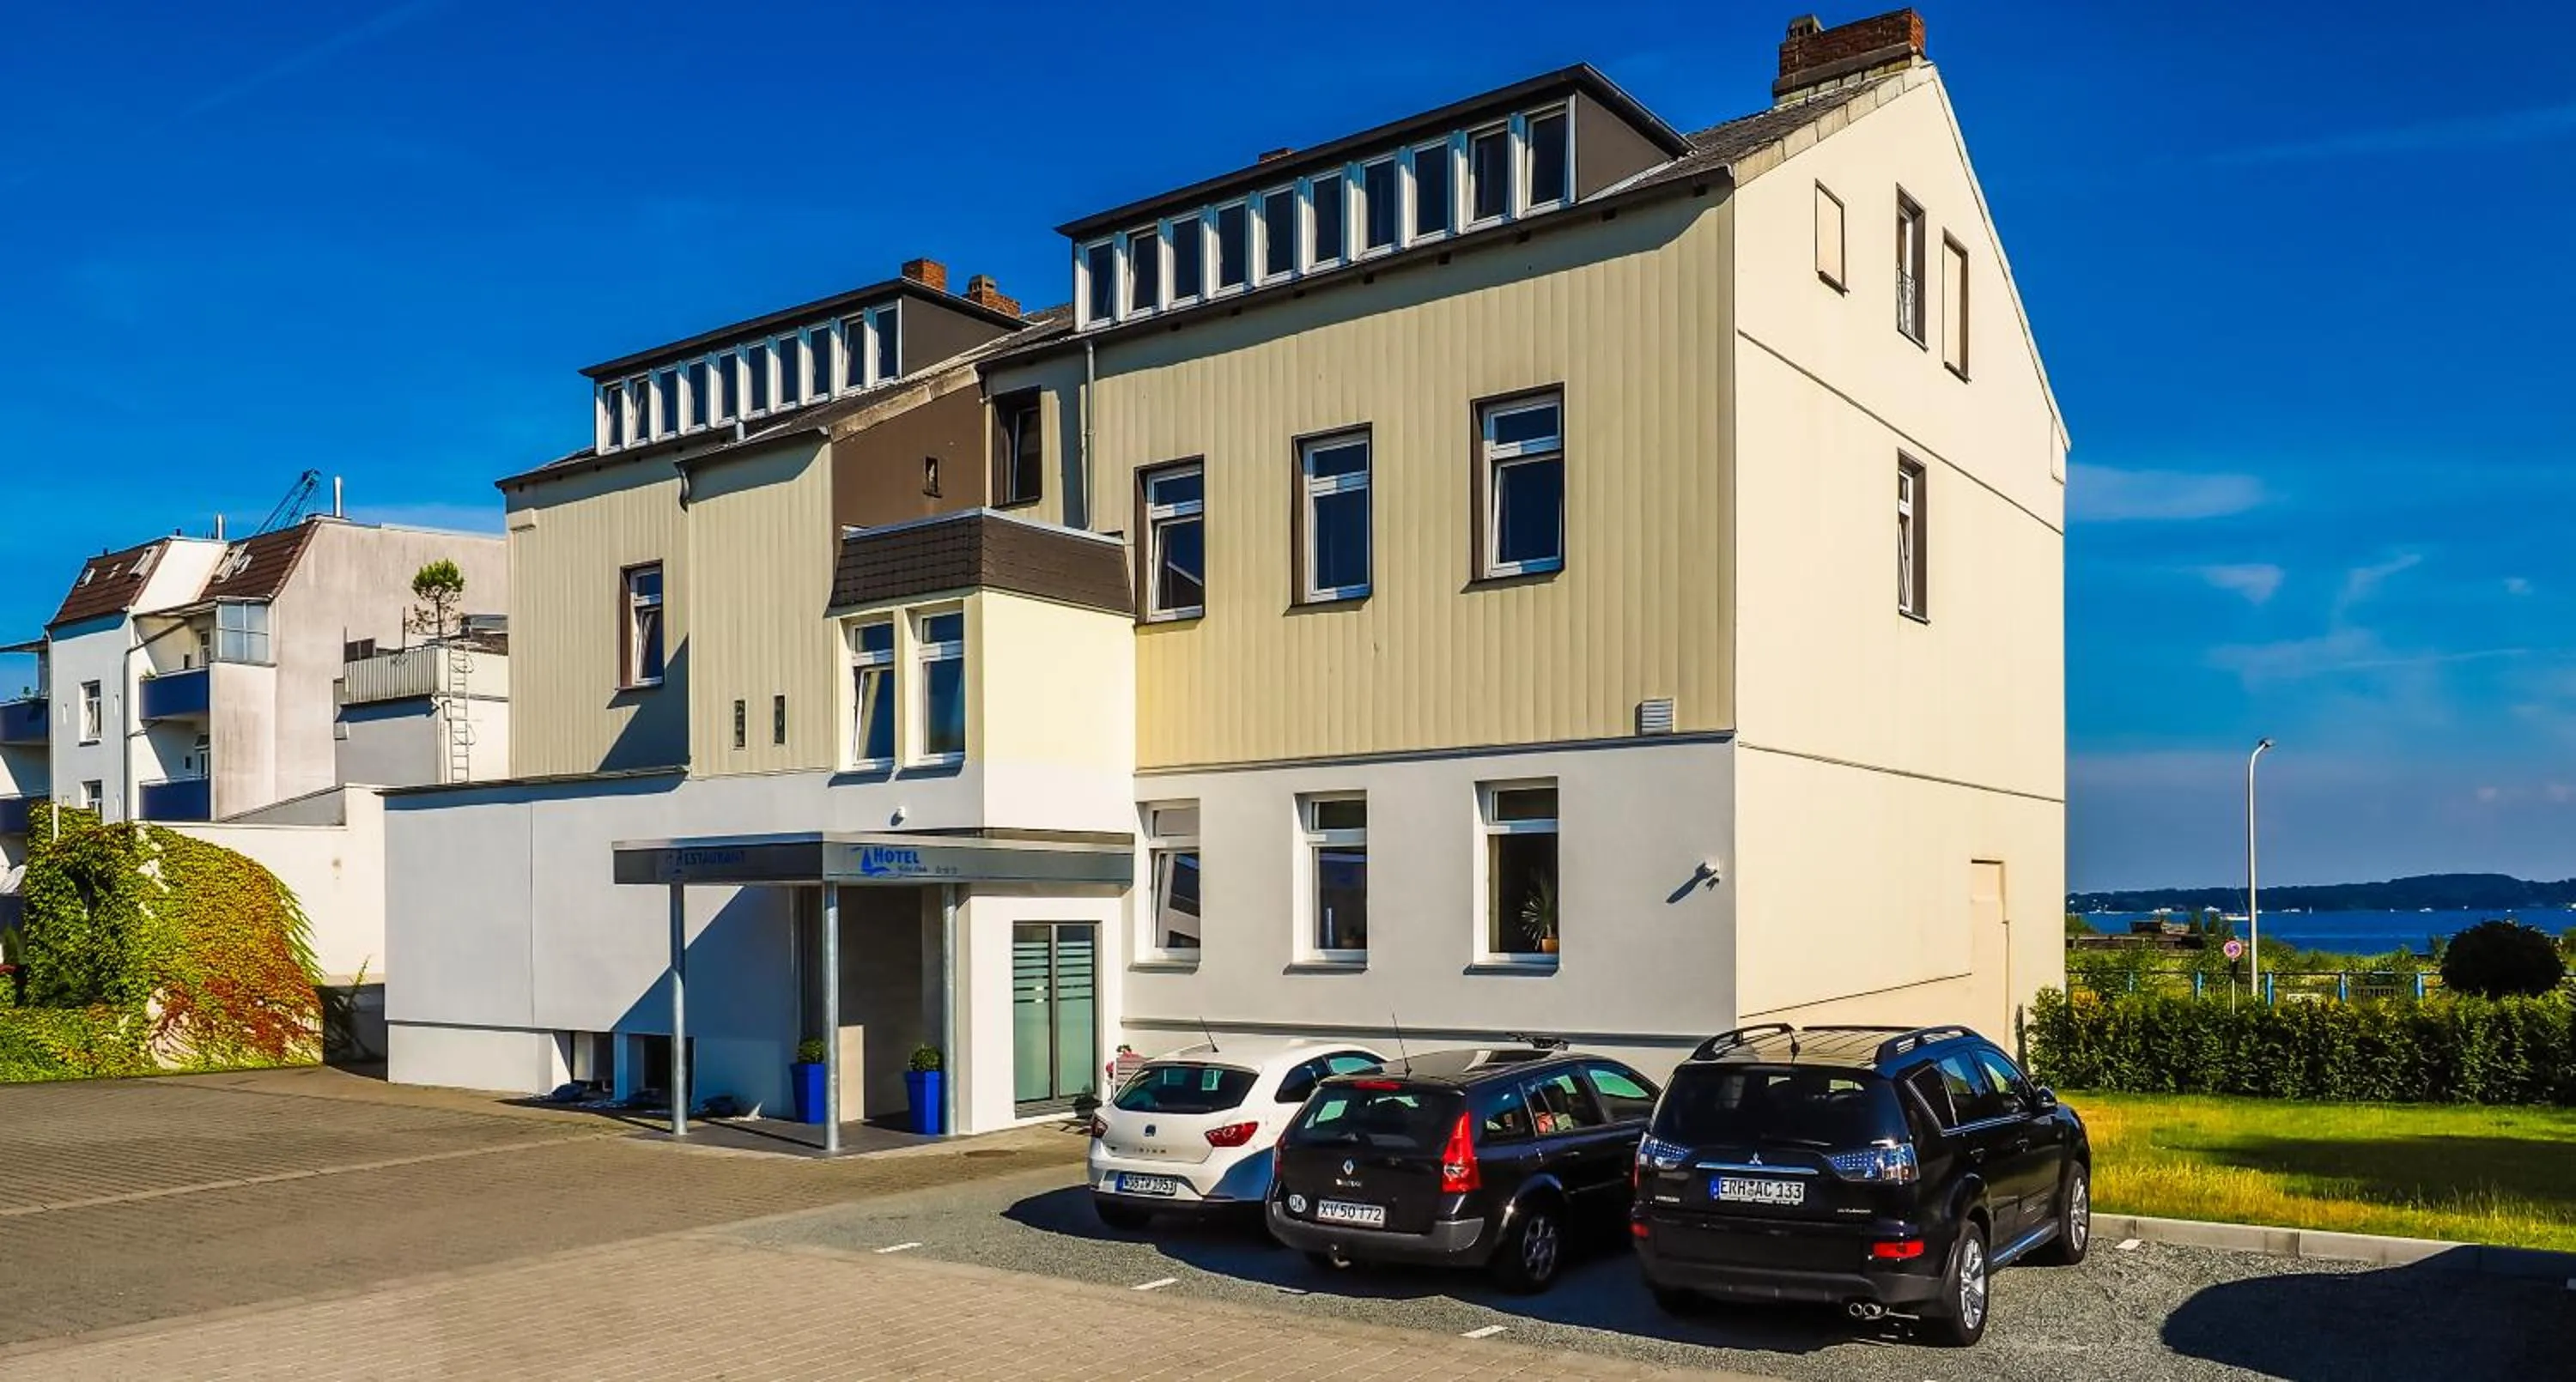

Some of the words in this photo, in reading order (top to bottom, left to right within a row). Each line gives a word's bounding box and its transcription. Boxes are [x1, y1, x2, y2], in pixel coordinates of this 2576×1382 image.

[873, 847, 920, 864] HOTEL
[1720, 1181, 1747, 1196] ERH
[1756, 1182, 1771, 1197] AC
[1777, 1184, 1802, 1199] 133
[1321, 1203, 1339, 1216] XV
[1340, 1204, 1356, 1218] 50
[1358, 1206, 1382, 1221] 172
